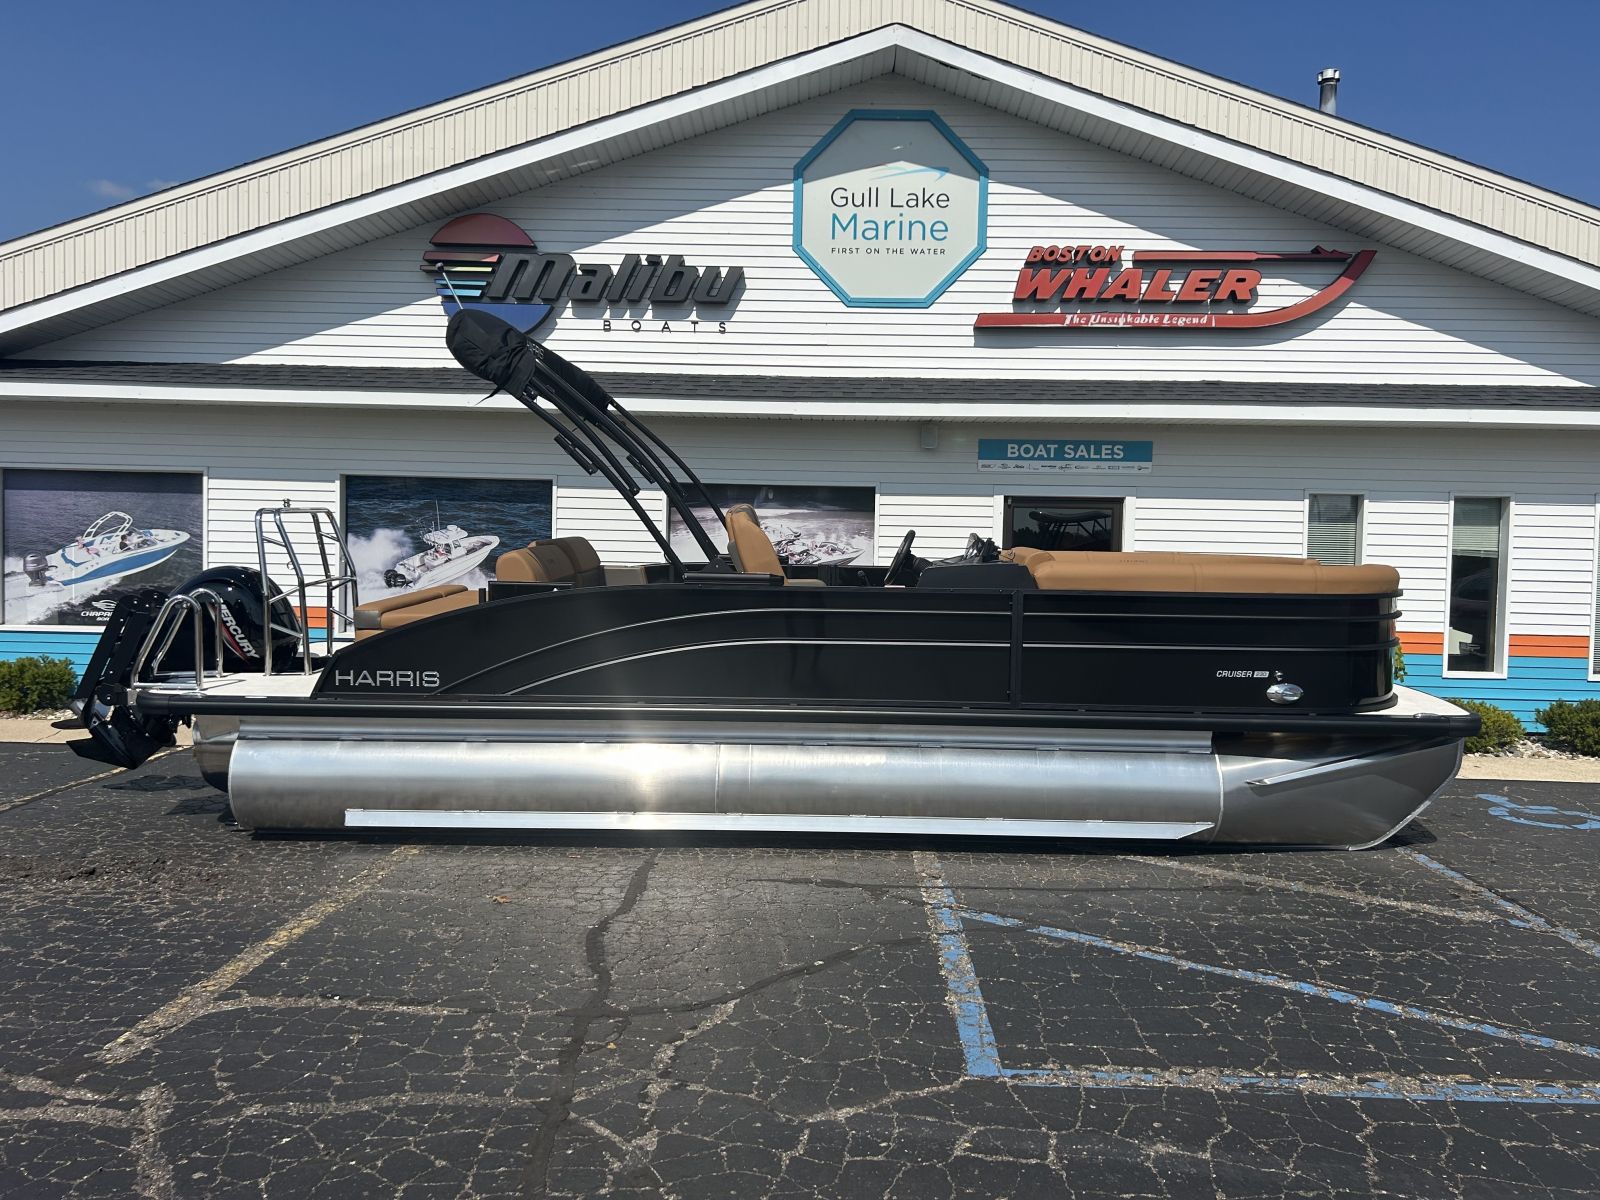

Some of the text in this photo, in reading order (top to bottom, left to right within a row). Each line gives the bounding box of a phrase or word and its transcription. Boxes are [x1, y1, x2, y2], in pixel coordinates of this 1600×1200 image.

[830, 187, 950, 209] Gull Lake
[831, 212, 949, 242] Marine
[831, 247, 860, 255] FIRST
[865, 247, 880, 255] ON
[886, 247, 905, 255] THE
[1026, 245, 1124, 265] BOSTON
[486, 253, 747, 303] Malibu
[1014, 267, 1262, 302] WHALER
[603, 320, 727, 333] BOATS
[1064, 314, 1087, 325] The
[1162, 314, 1208, 326] Legend
[1007, 443, 1124, 459] BOAT SALES
[335, 669, 440, 688] HARRIS
[1216, 670, 1253, 678] CRUISER
